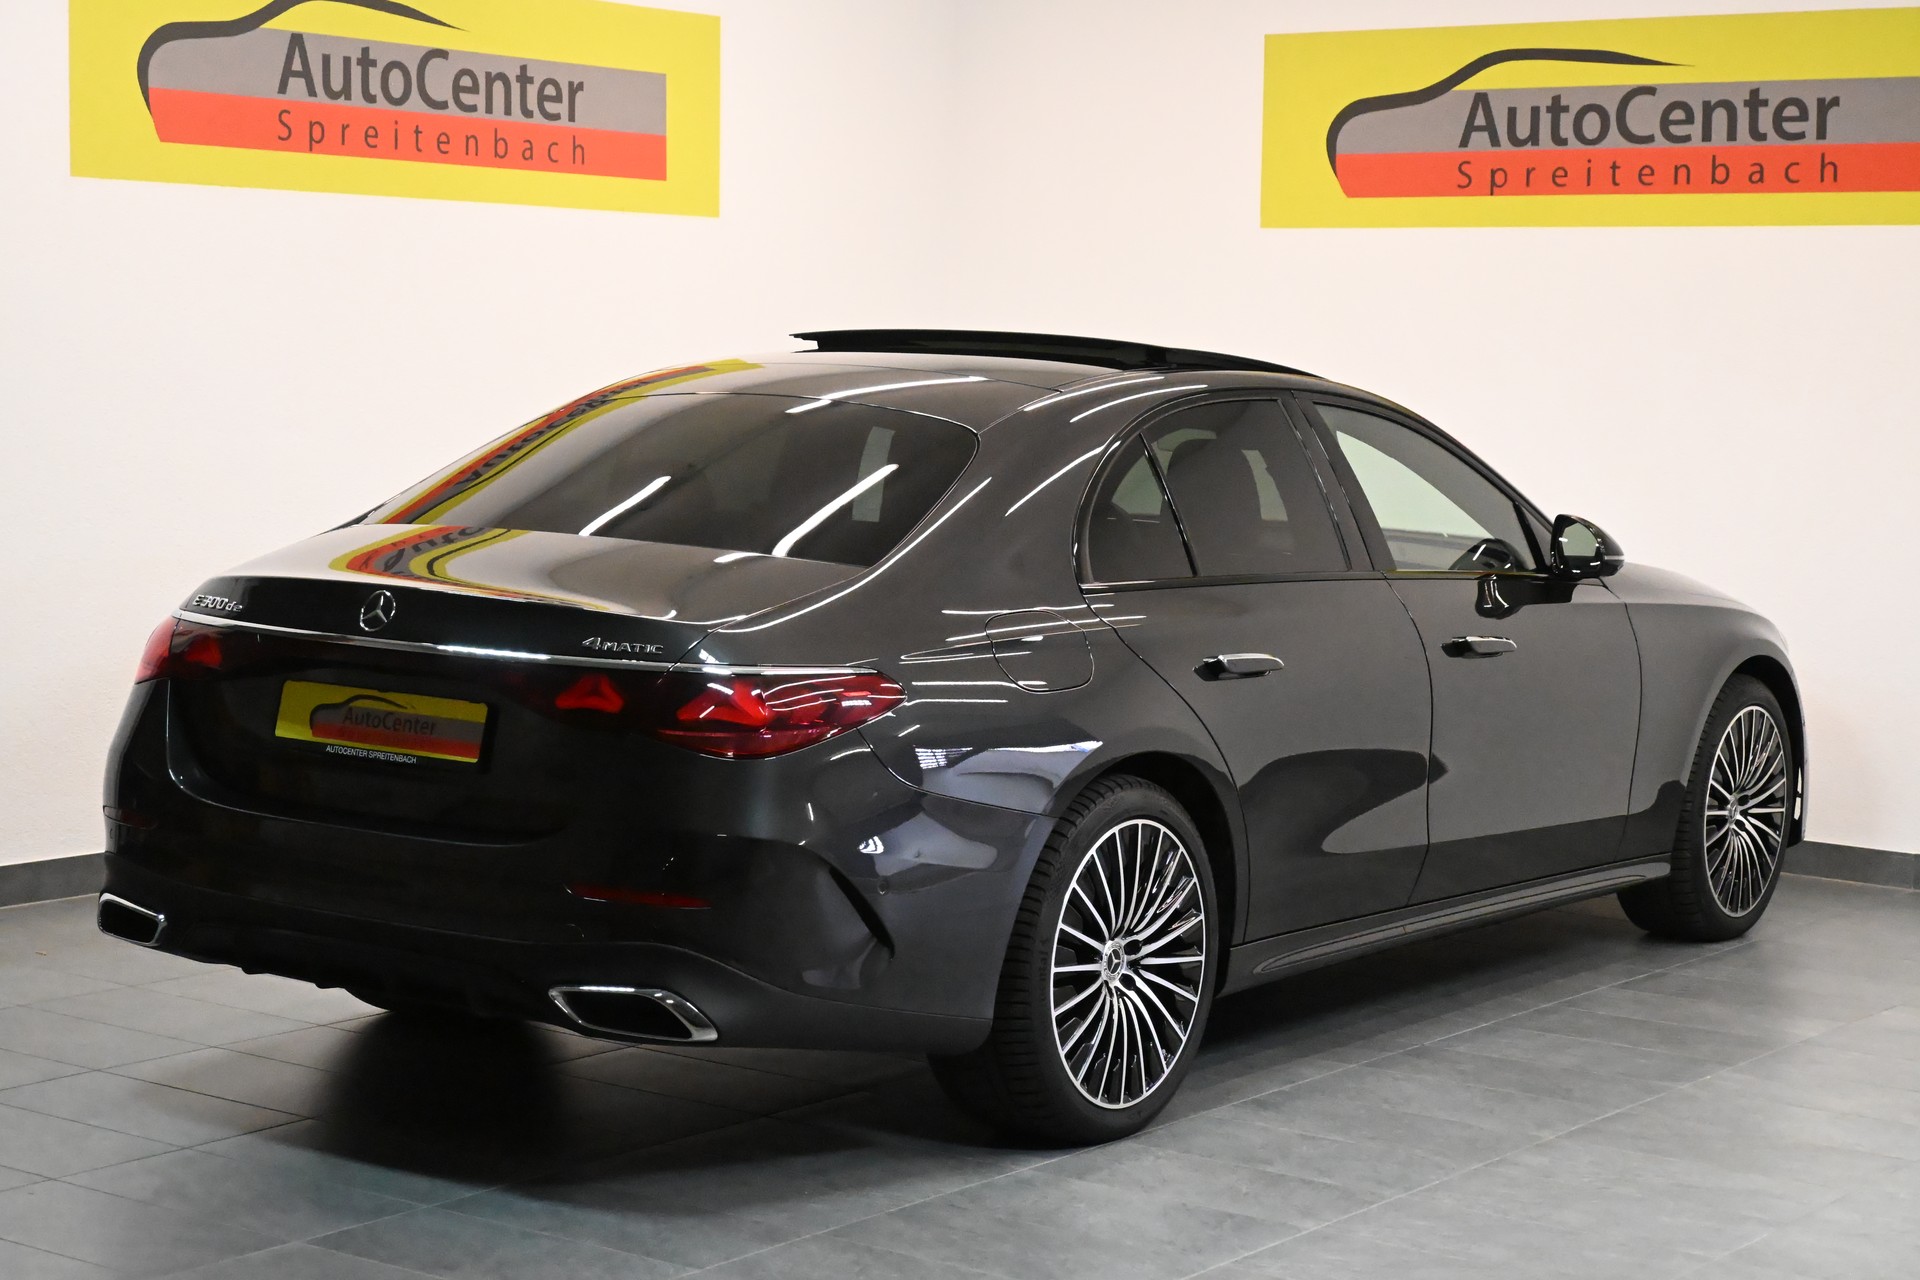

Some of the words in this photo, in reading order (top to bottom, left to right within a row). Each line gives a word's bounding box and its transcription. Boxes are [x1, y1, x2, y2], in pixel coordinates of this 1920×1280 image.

[277, 32, 584, 123] AutoCenter
[277, 109, 586, 165] Spreitenbach
[1457, 86, 1840, 149] AutoCenter
[1457, 153, 1840, 196] Spreitenbach
[582, 637, 664, 654] 4MATIC
[342, 708, 437, 734] AutoCenter
[326, 744, 368, 757] AUTOCENTER
[368, 750, 417, 764] SPREITENBACH
